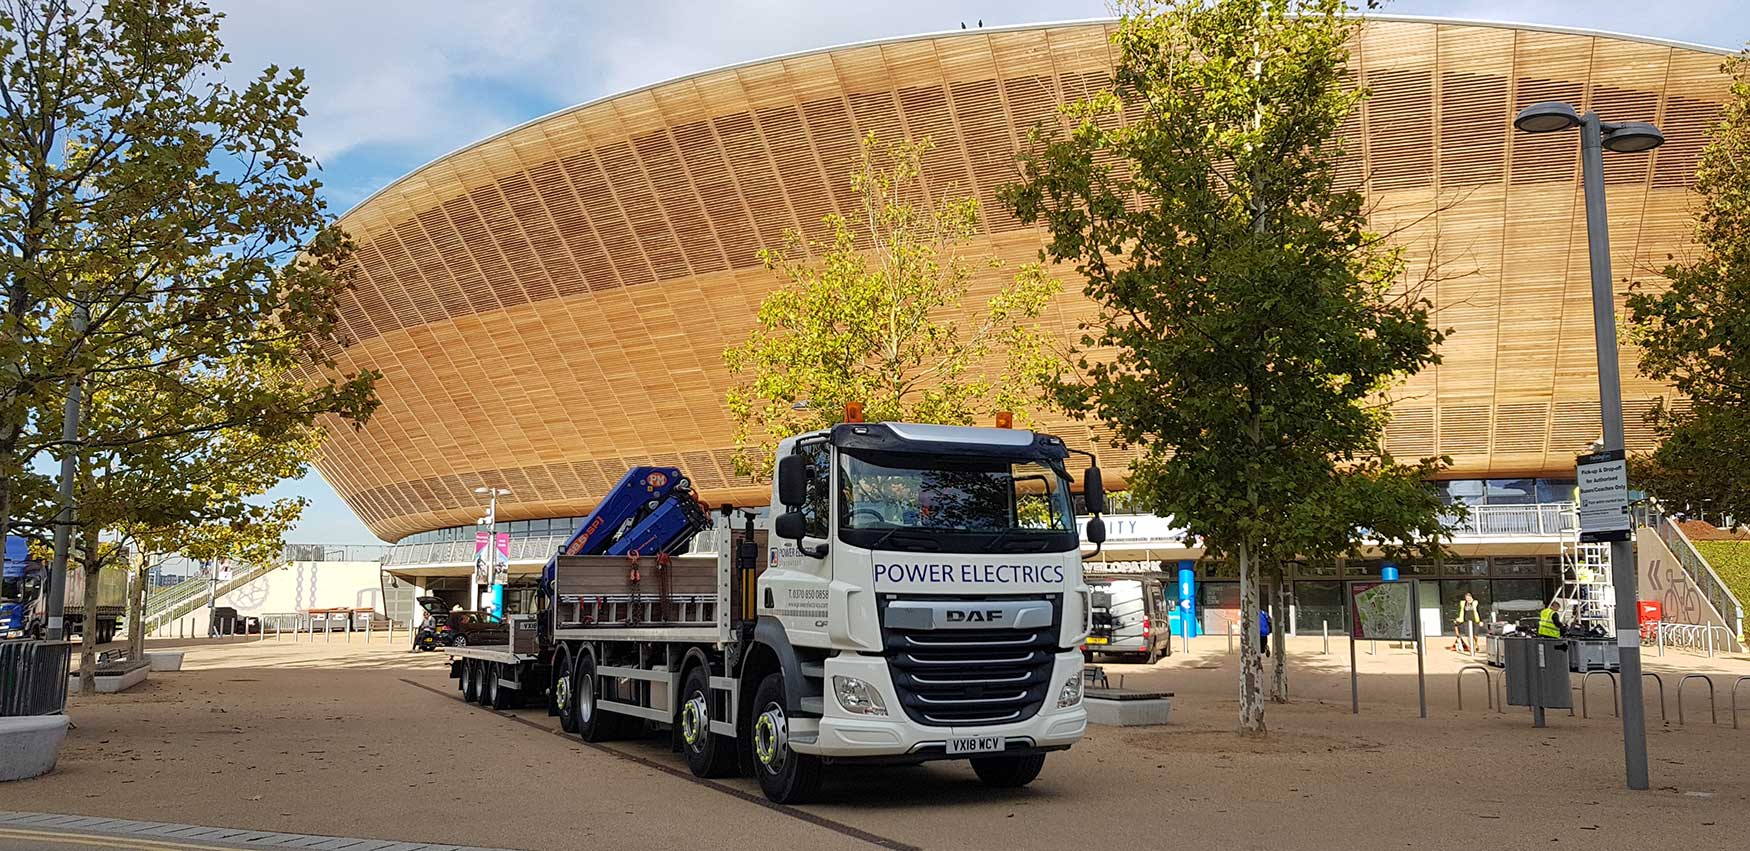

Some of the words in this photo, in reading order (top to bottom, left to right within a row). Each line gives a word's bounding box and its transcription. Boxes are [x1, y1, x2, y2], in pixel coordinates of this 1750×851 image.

[650, 473, 666, 486] PM
[1593, 475, 1618, 483] Authorised
[1082, 560, 1162, 573] VELOPARK
[874, 564, 954, 583] POWER
[961, 564, 1064, 584] ELECTRICS
[946, 610, 1002, 622] DAF
[953, 738, 976, 751] VX18
[978, 737, 999, 750] WCV
